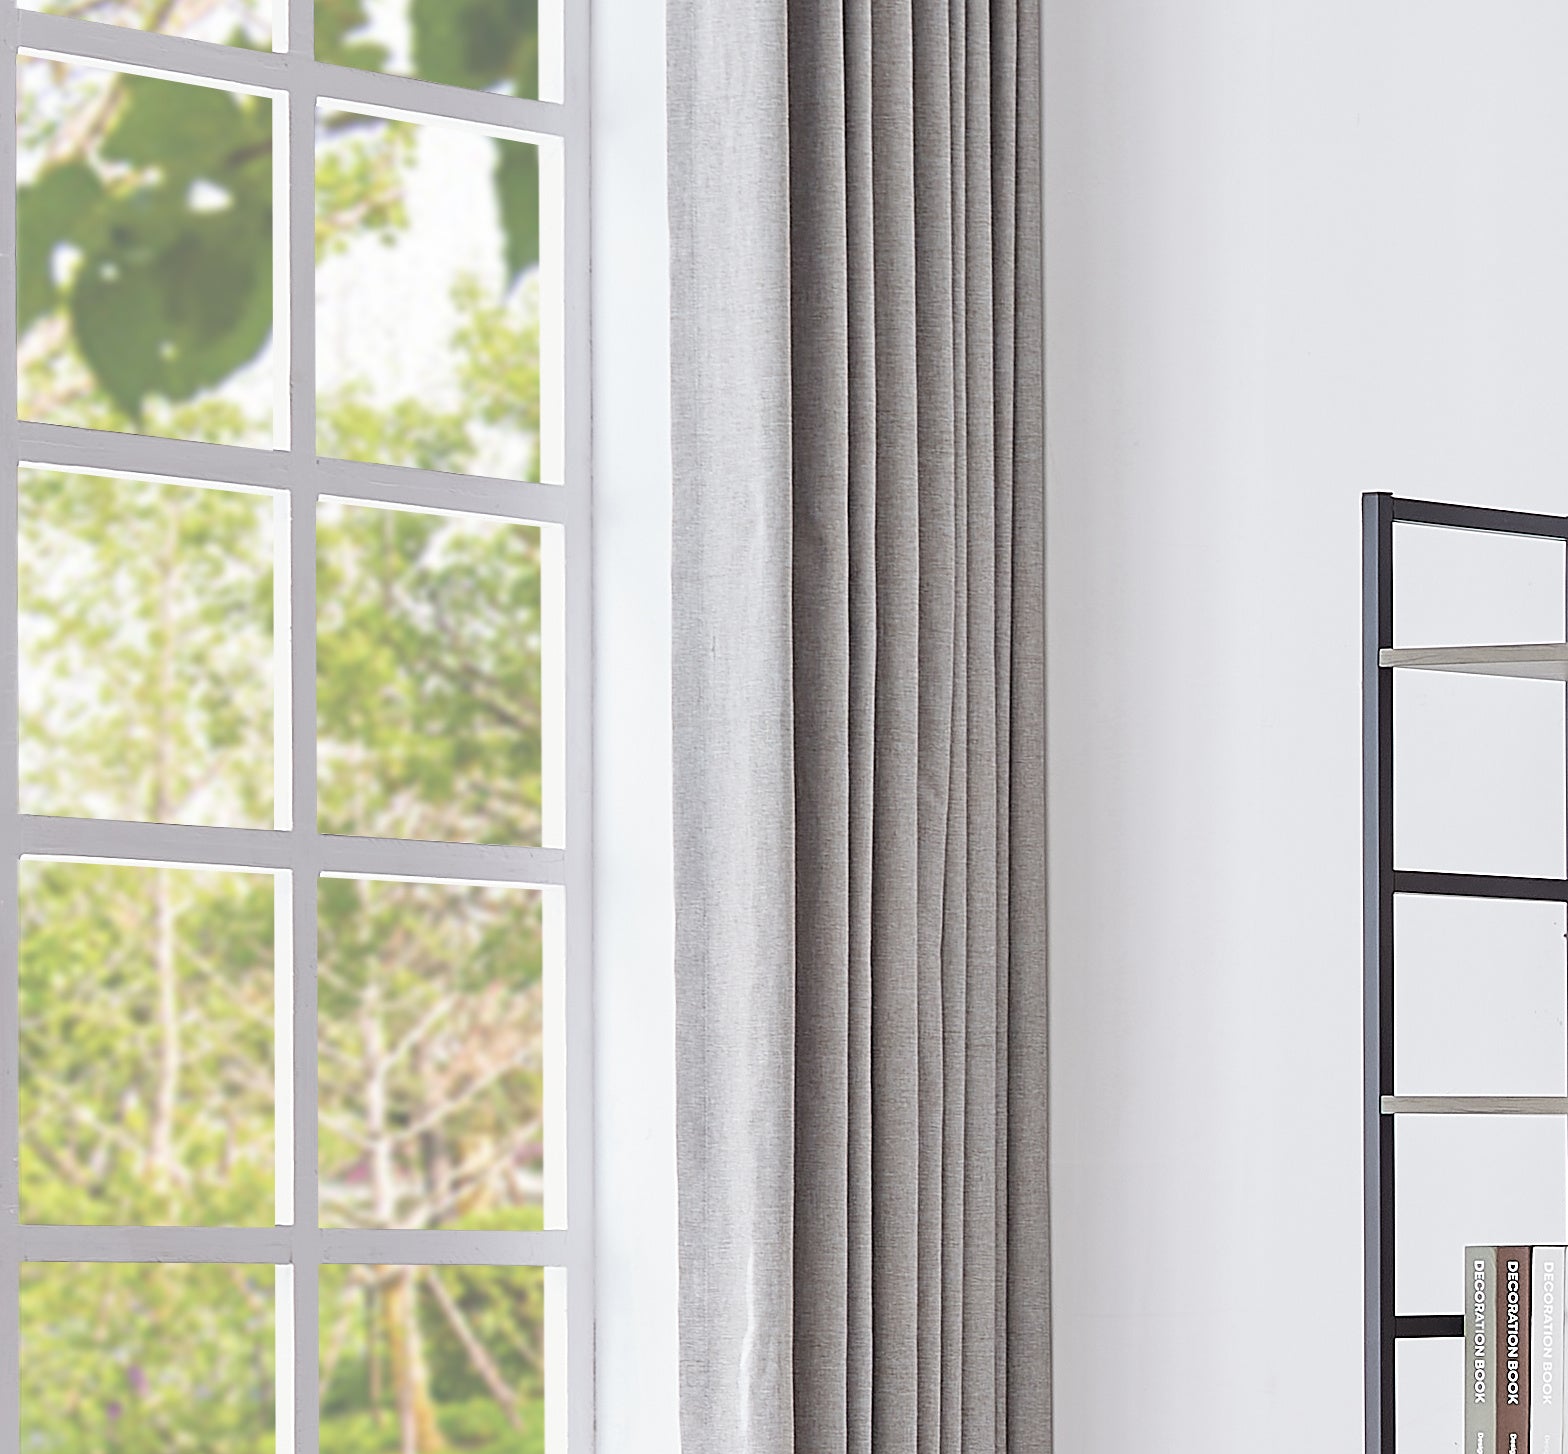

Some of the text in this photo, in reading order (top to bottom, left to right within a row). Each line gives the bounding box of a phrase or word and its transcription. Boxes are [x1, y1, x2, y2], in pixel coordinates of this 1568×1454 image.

[1474, 1260, 1486, 1404] DECORATION BOOK
[1507, 1261, 1519, 1405] DECORATION BOOK
[1542, 1262, 1554, 1405] DECORATION BOOK
